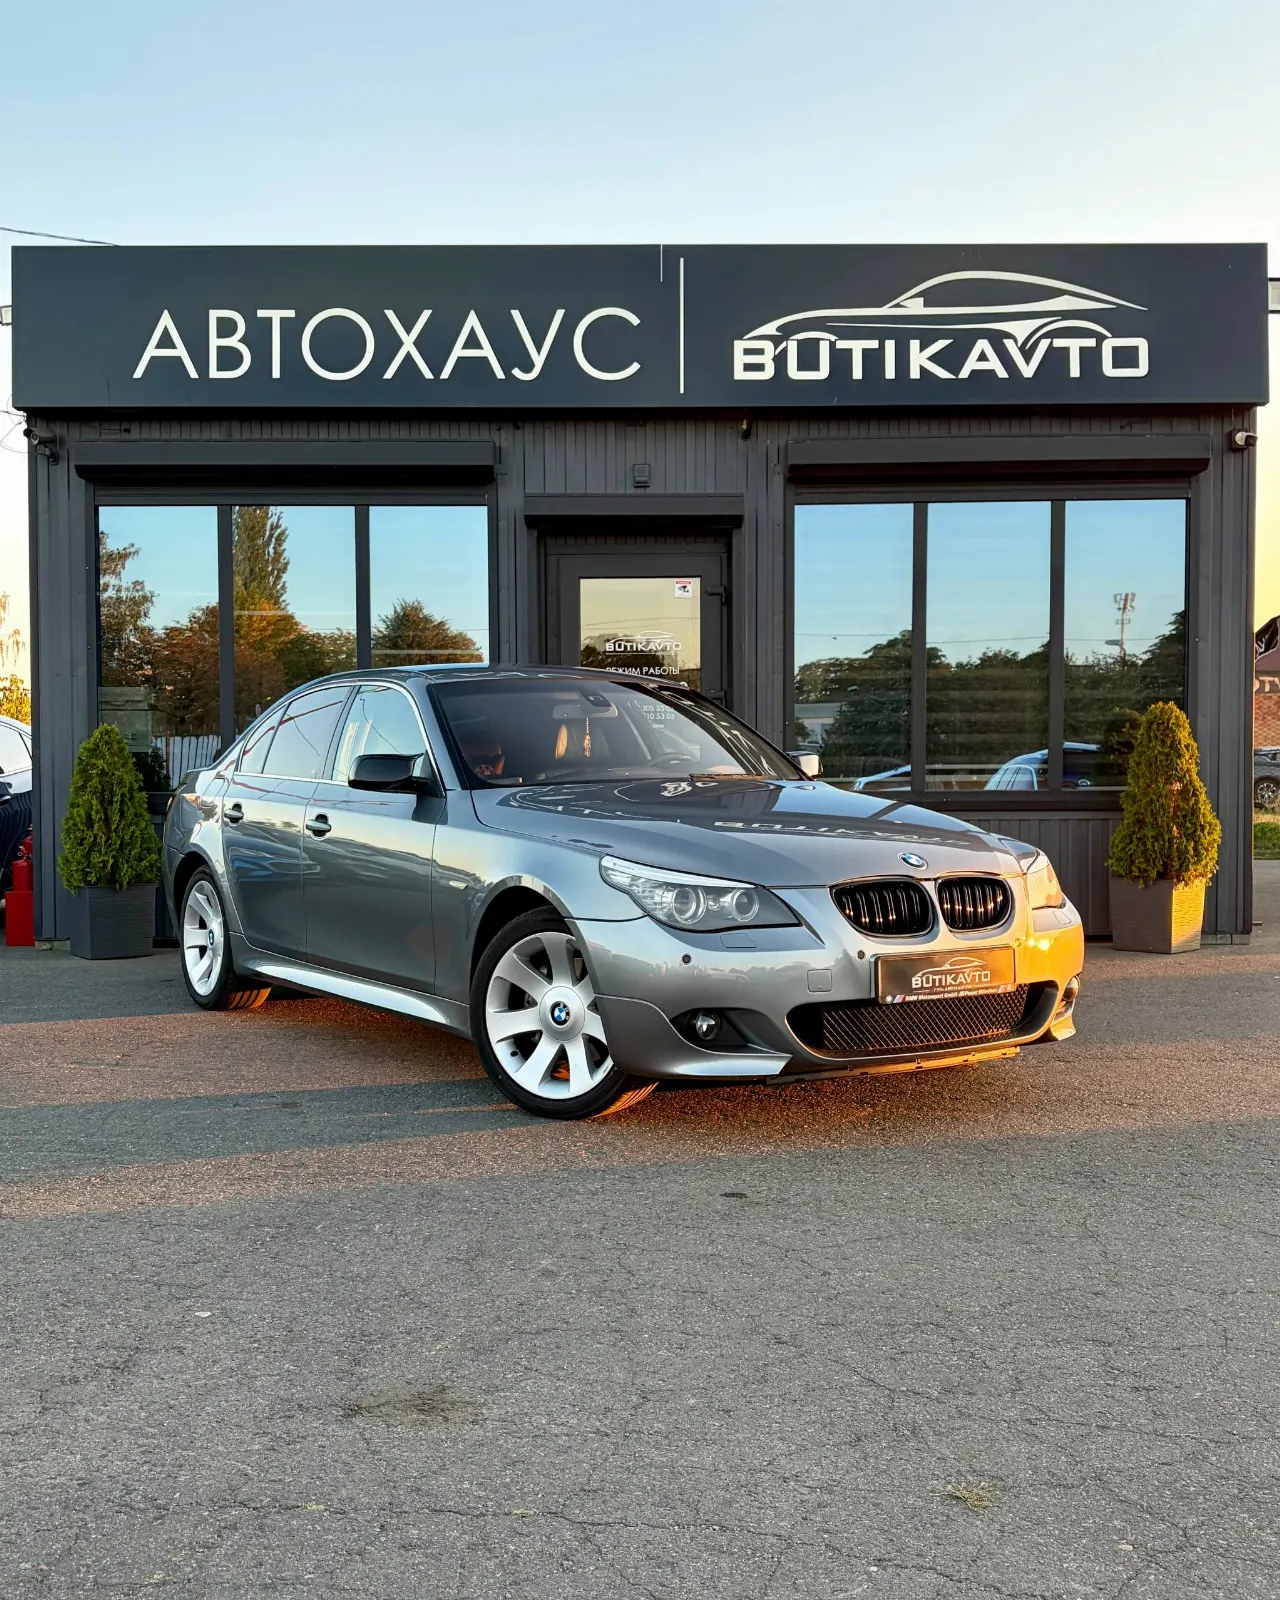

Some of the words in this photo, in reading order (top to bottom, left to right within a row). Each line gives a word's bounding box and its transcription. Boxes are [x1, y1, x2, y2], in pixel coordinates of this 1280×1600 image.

[133, 307, 641, 381] АВТОХАУС
[733, 338, 1150, 381] BUTIKAVTO
[605, 642, 682, 651] BUTIKAVTO
[643, 666, 680, 675] РАБОТЫ
[912, 971, 990, 988] BUTIKAVTO
